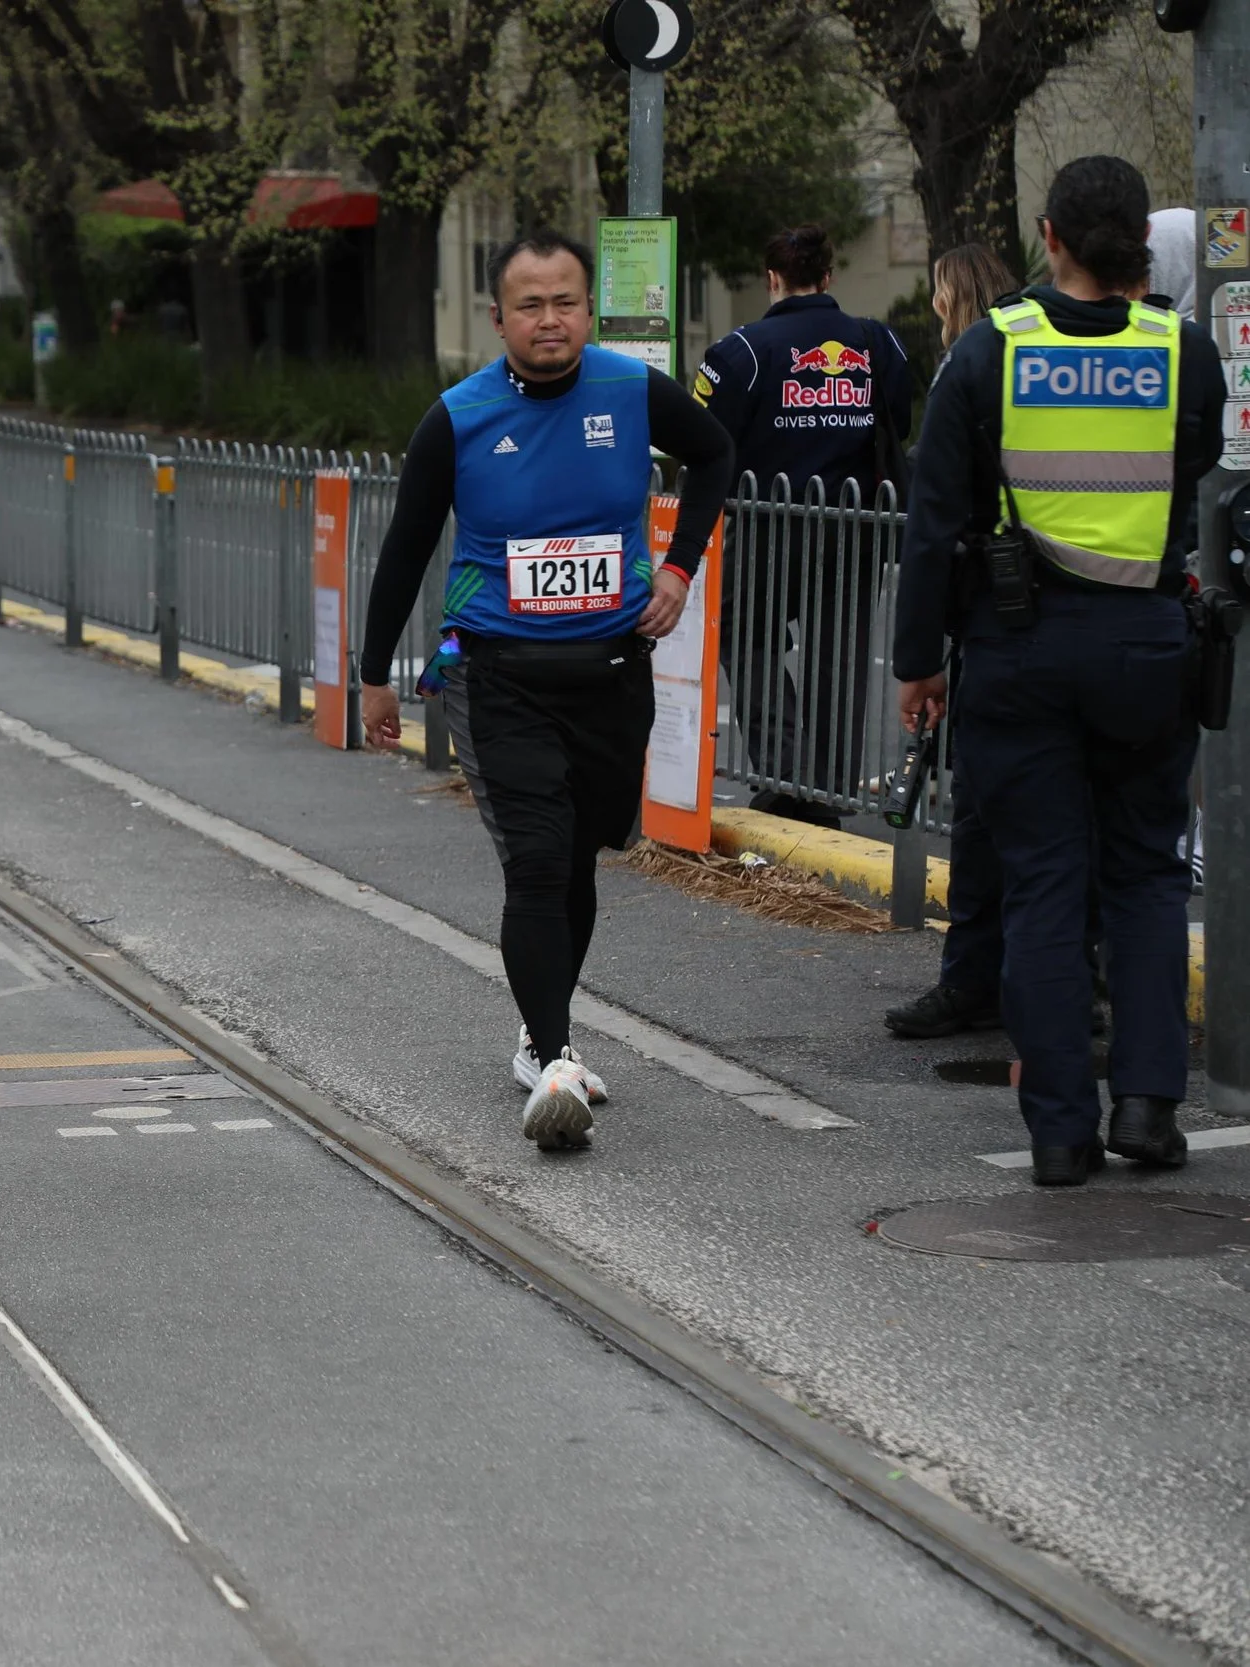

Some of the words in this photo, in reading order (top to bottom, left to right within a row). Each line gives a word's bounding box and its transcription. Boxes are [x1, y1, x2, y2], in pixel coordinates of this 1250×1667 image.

[699, 361, 721, 384] ASIO
[1019, 357, 1162, 396] Police
[782, 377, 834, 408] Red
[836, 378, 872, 408] Bul
[774, 415, 817, 428] GIVES
[820, 414, 847, 427] YOU
[848, 413, 875, 427] WING
[494, 446, 519, 454] adidas
[654, 526, 668, 541] Tram
[527, 558, 610, 597] 12314
[520, 600, 584, 612] MELBOURNE
[586, 598, 612, 609] 2025
